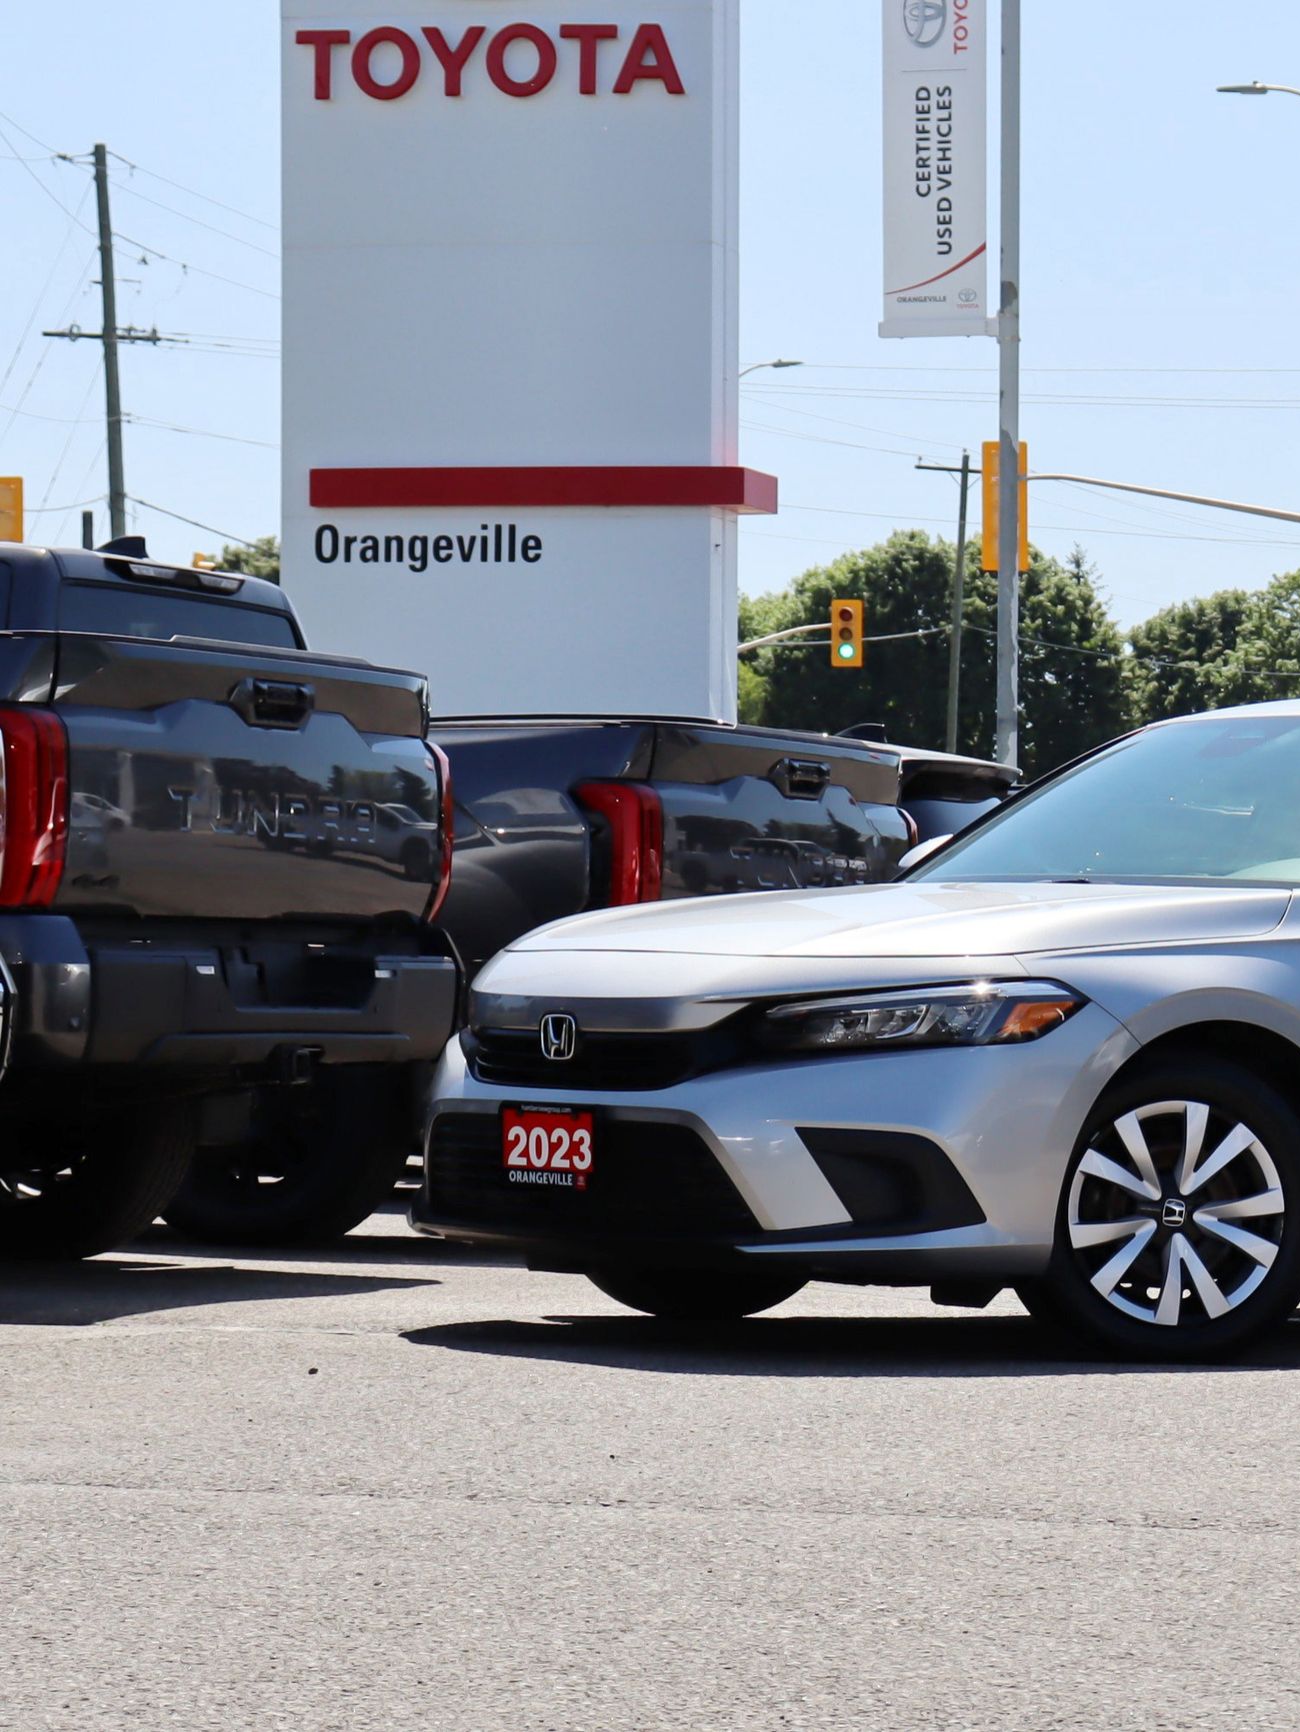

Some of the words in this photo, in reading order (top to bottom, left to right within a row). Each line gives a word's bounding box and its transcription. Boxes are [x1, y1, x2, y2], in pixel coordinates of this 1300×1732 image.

[296, 23, 686, 100] TOYOTA
[915, 86, 931, 198] CERTIFIED
[937, 85, 952, 191] VEHICLES
[937, 197, 952, 256] USED
[896, 295, 947, 303] ORANGEVILLE
[314, 525, 543, 572] Orangeville
[507, 1125, 592, 1170] 2023
[508, 1170, 573, 1186] ORANGEVILLE
